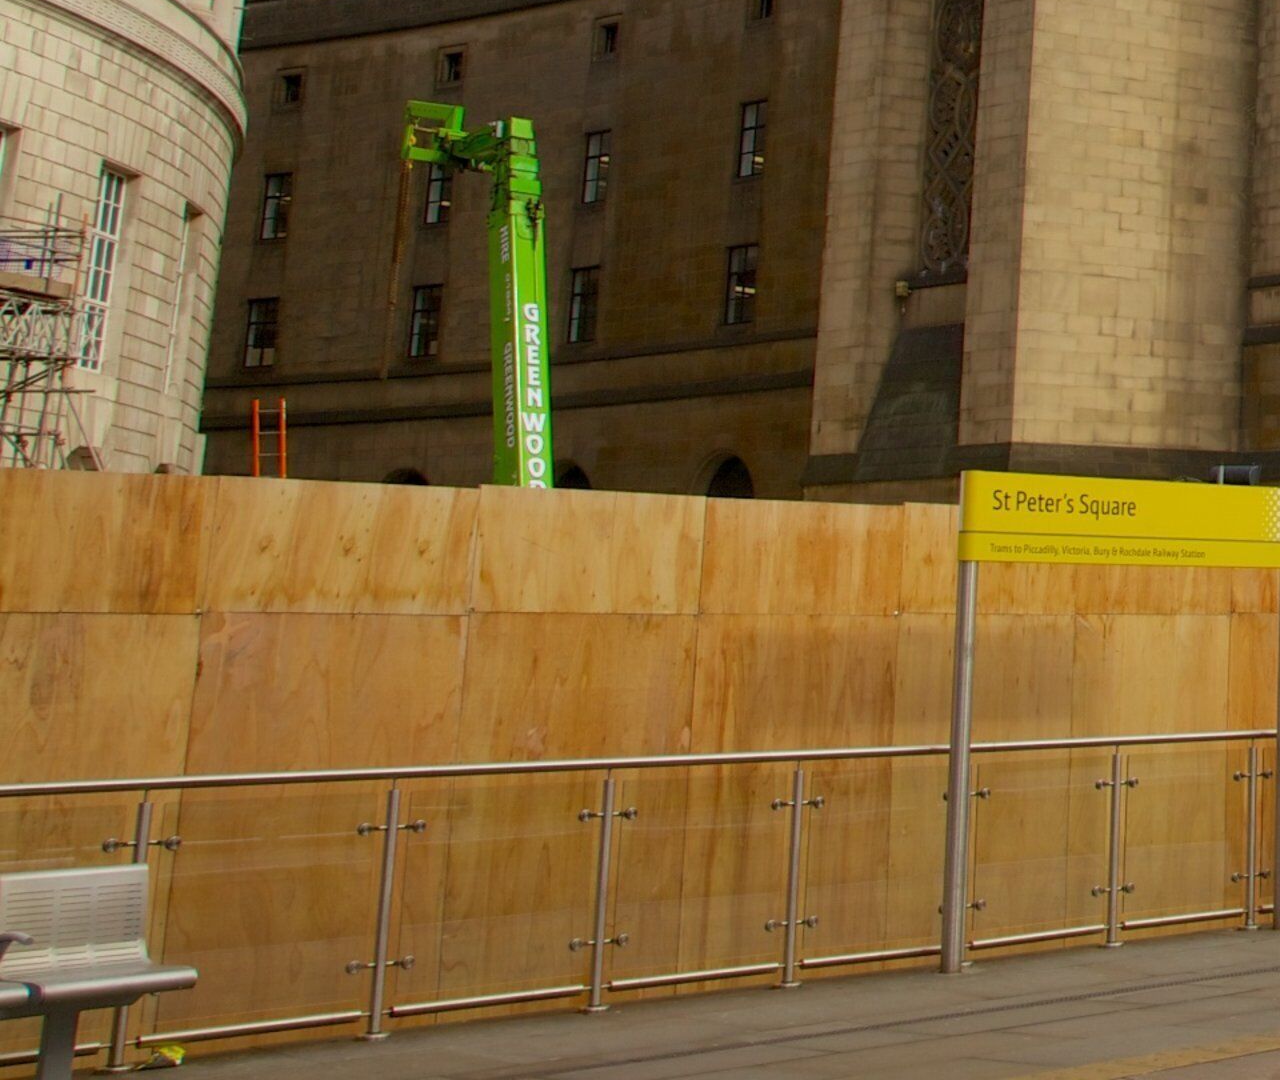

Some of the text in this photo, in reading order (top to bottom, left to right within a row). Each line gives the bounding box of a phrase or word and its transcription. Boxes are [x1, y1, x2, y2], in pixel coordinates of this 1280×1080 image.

[504, 342, 515, 448] GREENWOOD
[992, 489, 1136, 520] St Peter's Square
[990, 543, 1012, 554] Trams
[1014, 544, 1022, 554] to
[1024, 544, 1059, 557] Piccadilly,
[1094, 547, 1110, 558] Bury
[1112, 548, 1117, 556] &
[1120, 547, 1151, 557] Rochdale
[1153, 549, 1179, 560] Railway
[1181, 550, 1206, 559] Station
